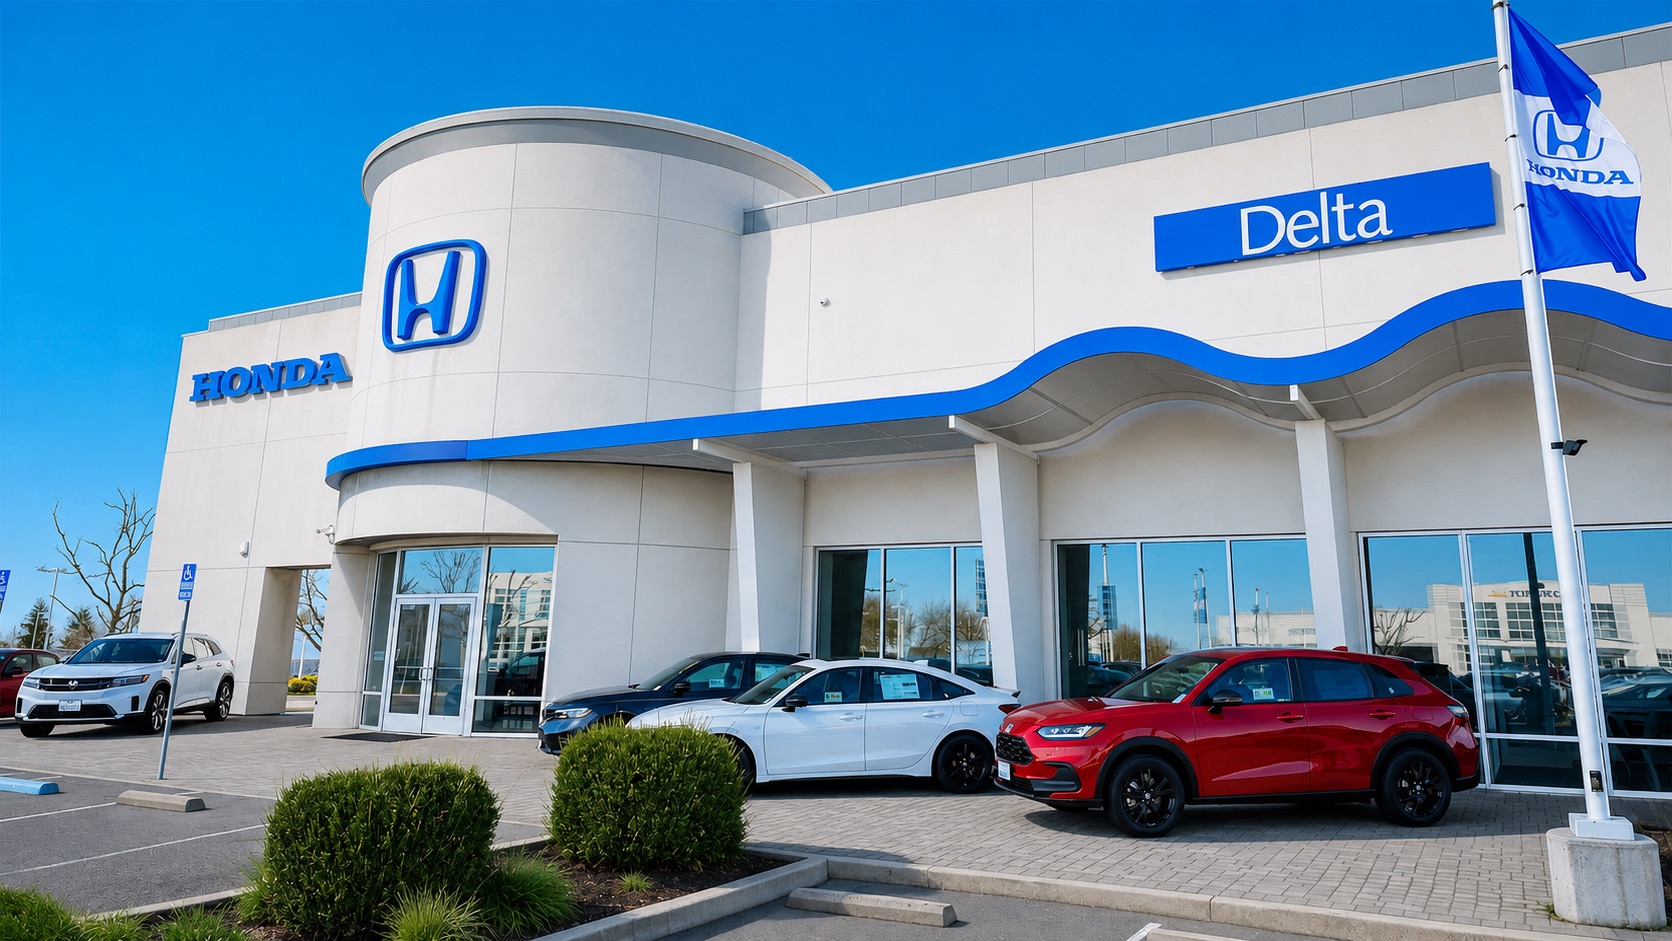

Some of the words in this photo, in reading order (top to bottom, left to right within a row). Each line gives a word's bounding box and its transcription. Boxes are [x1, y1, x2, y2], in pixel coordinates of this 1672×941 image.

[1526, 159, 1634, 184] HONDA
[1240, 191, 1393, 256] Delta
[189, 352, 353, 402] HONDA
